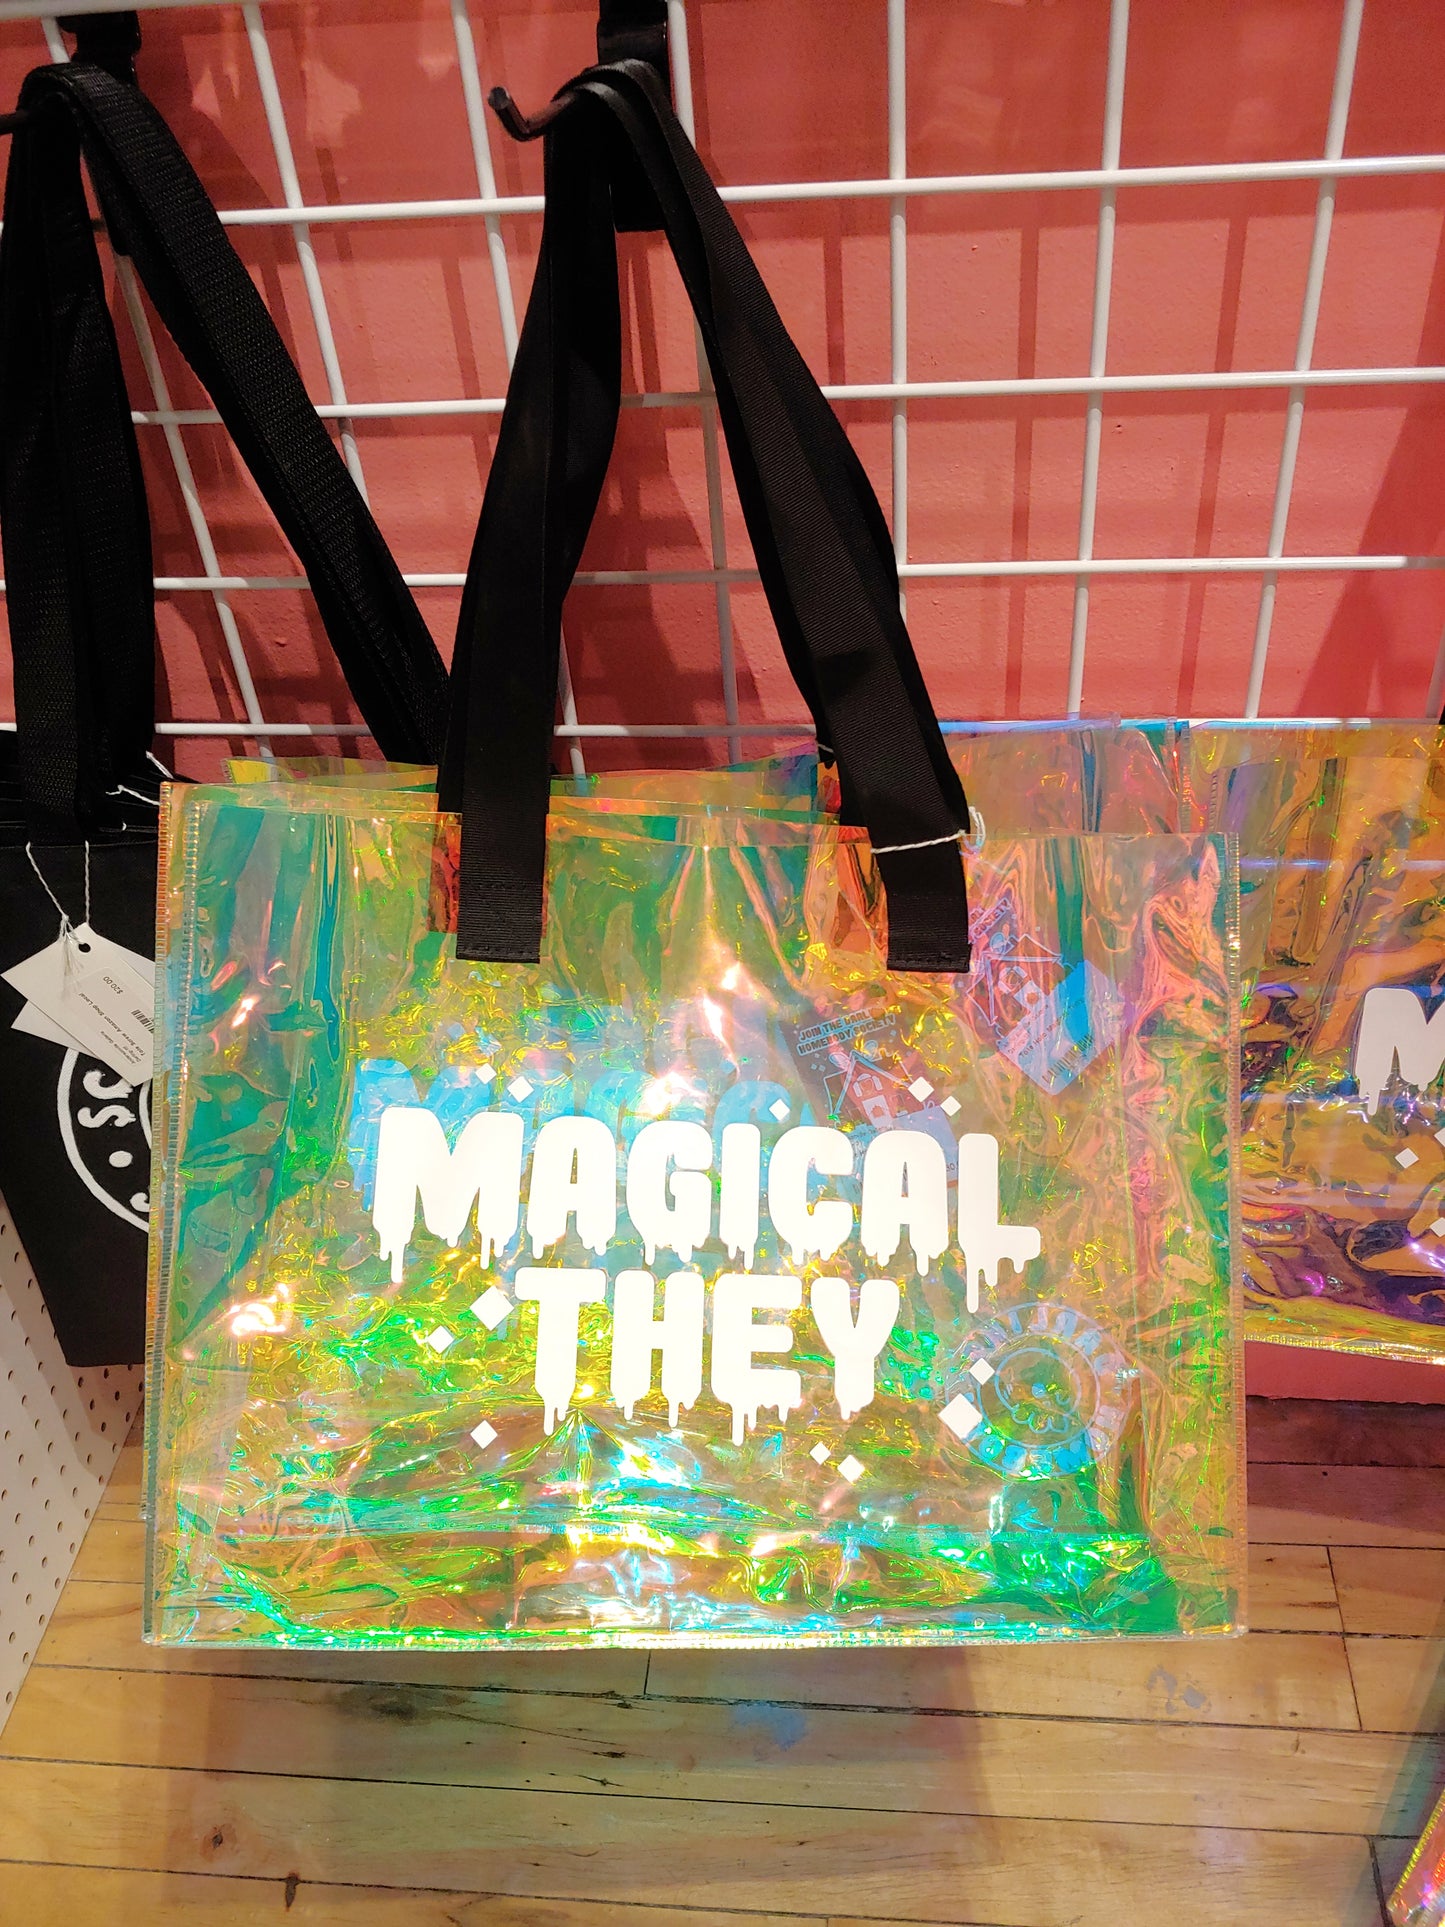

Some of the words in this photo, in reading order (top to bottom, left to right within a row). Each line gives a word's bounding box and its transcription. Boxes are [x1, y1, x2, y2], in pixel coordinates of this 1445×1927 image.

[797, 1031, 853, 1055] HOMEBODY
[799, 1026, 822, 1041] JOIN
[822, 1019, 843, 1033] THE
[372, 1107, 1041, 1313] MAGICAL
[514, 1267, 901, 1446] THEY
